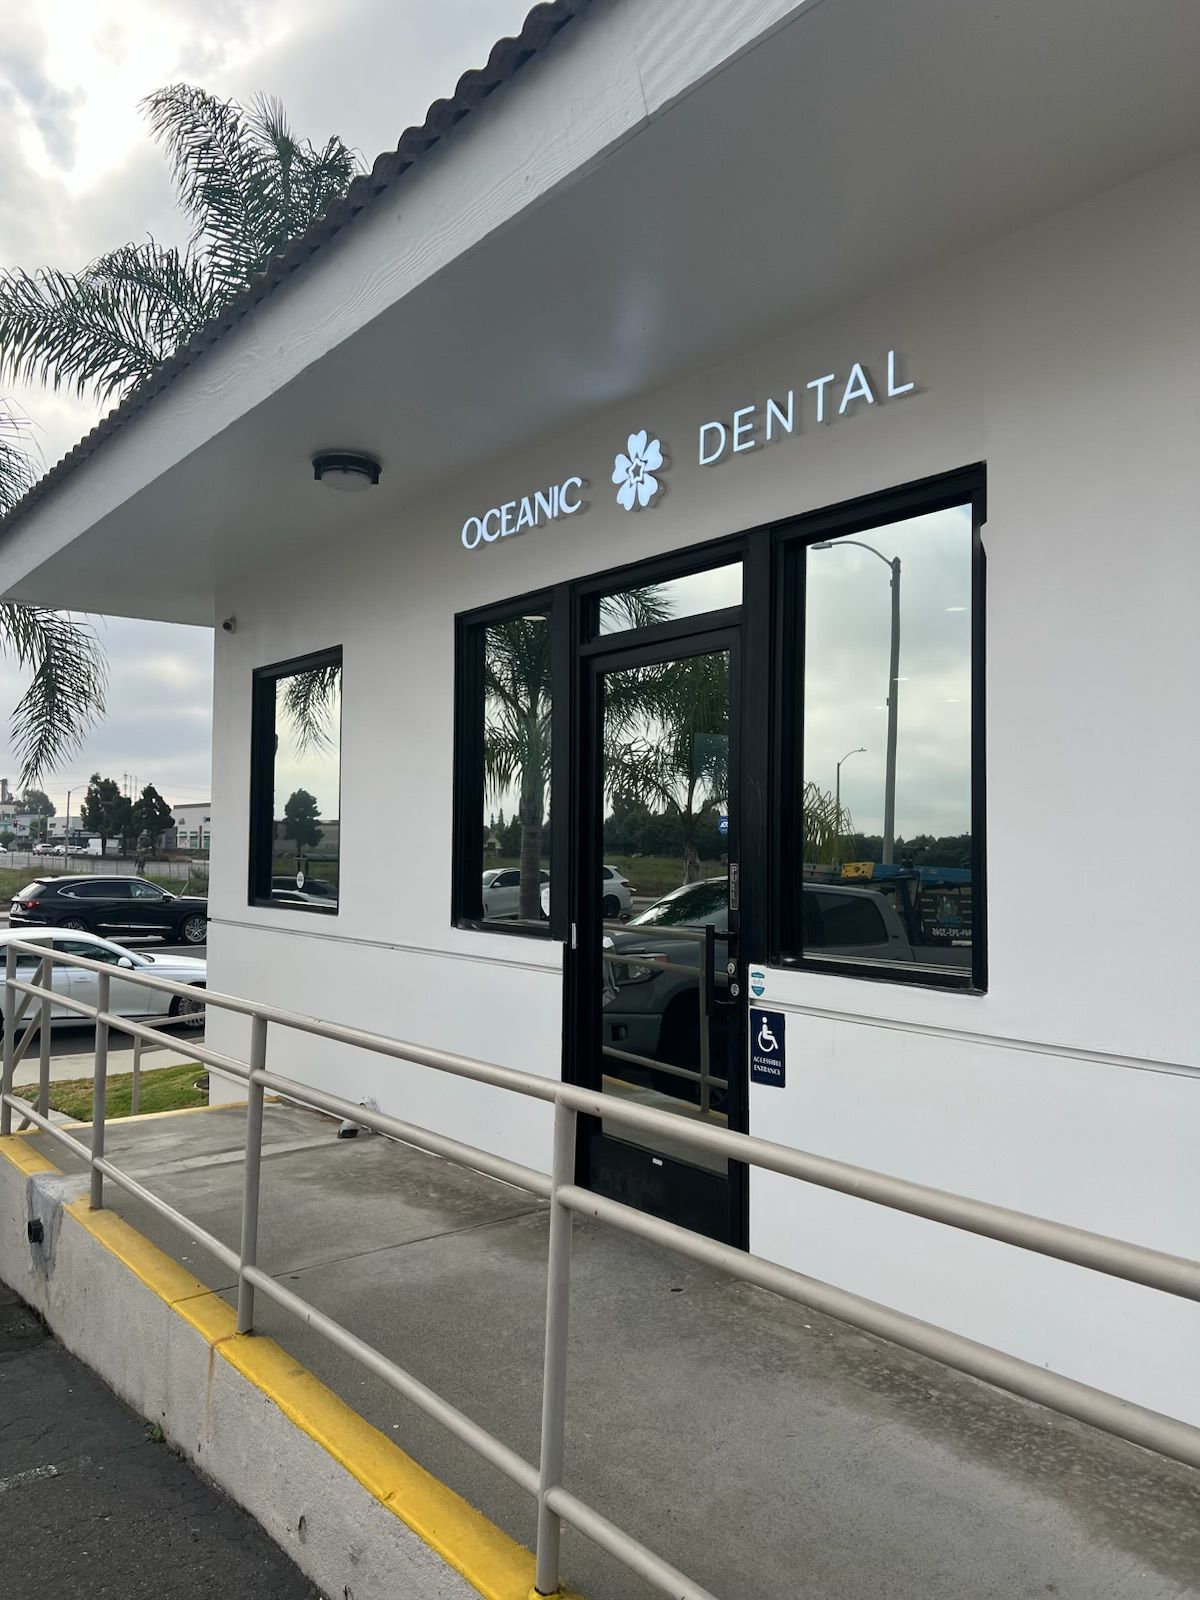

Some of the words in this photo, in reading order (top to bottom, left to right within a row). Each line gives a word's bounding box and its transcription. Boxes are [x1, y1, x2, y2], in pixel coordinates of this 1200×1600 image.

[461, 476, 582, 549] OCEANIC
[699, 350, 914, 465] DENTAL
[753, 1055, 782, 1068] ACCESSIBLE
[753, 1064, 781, 1076] ENTRANCE
